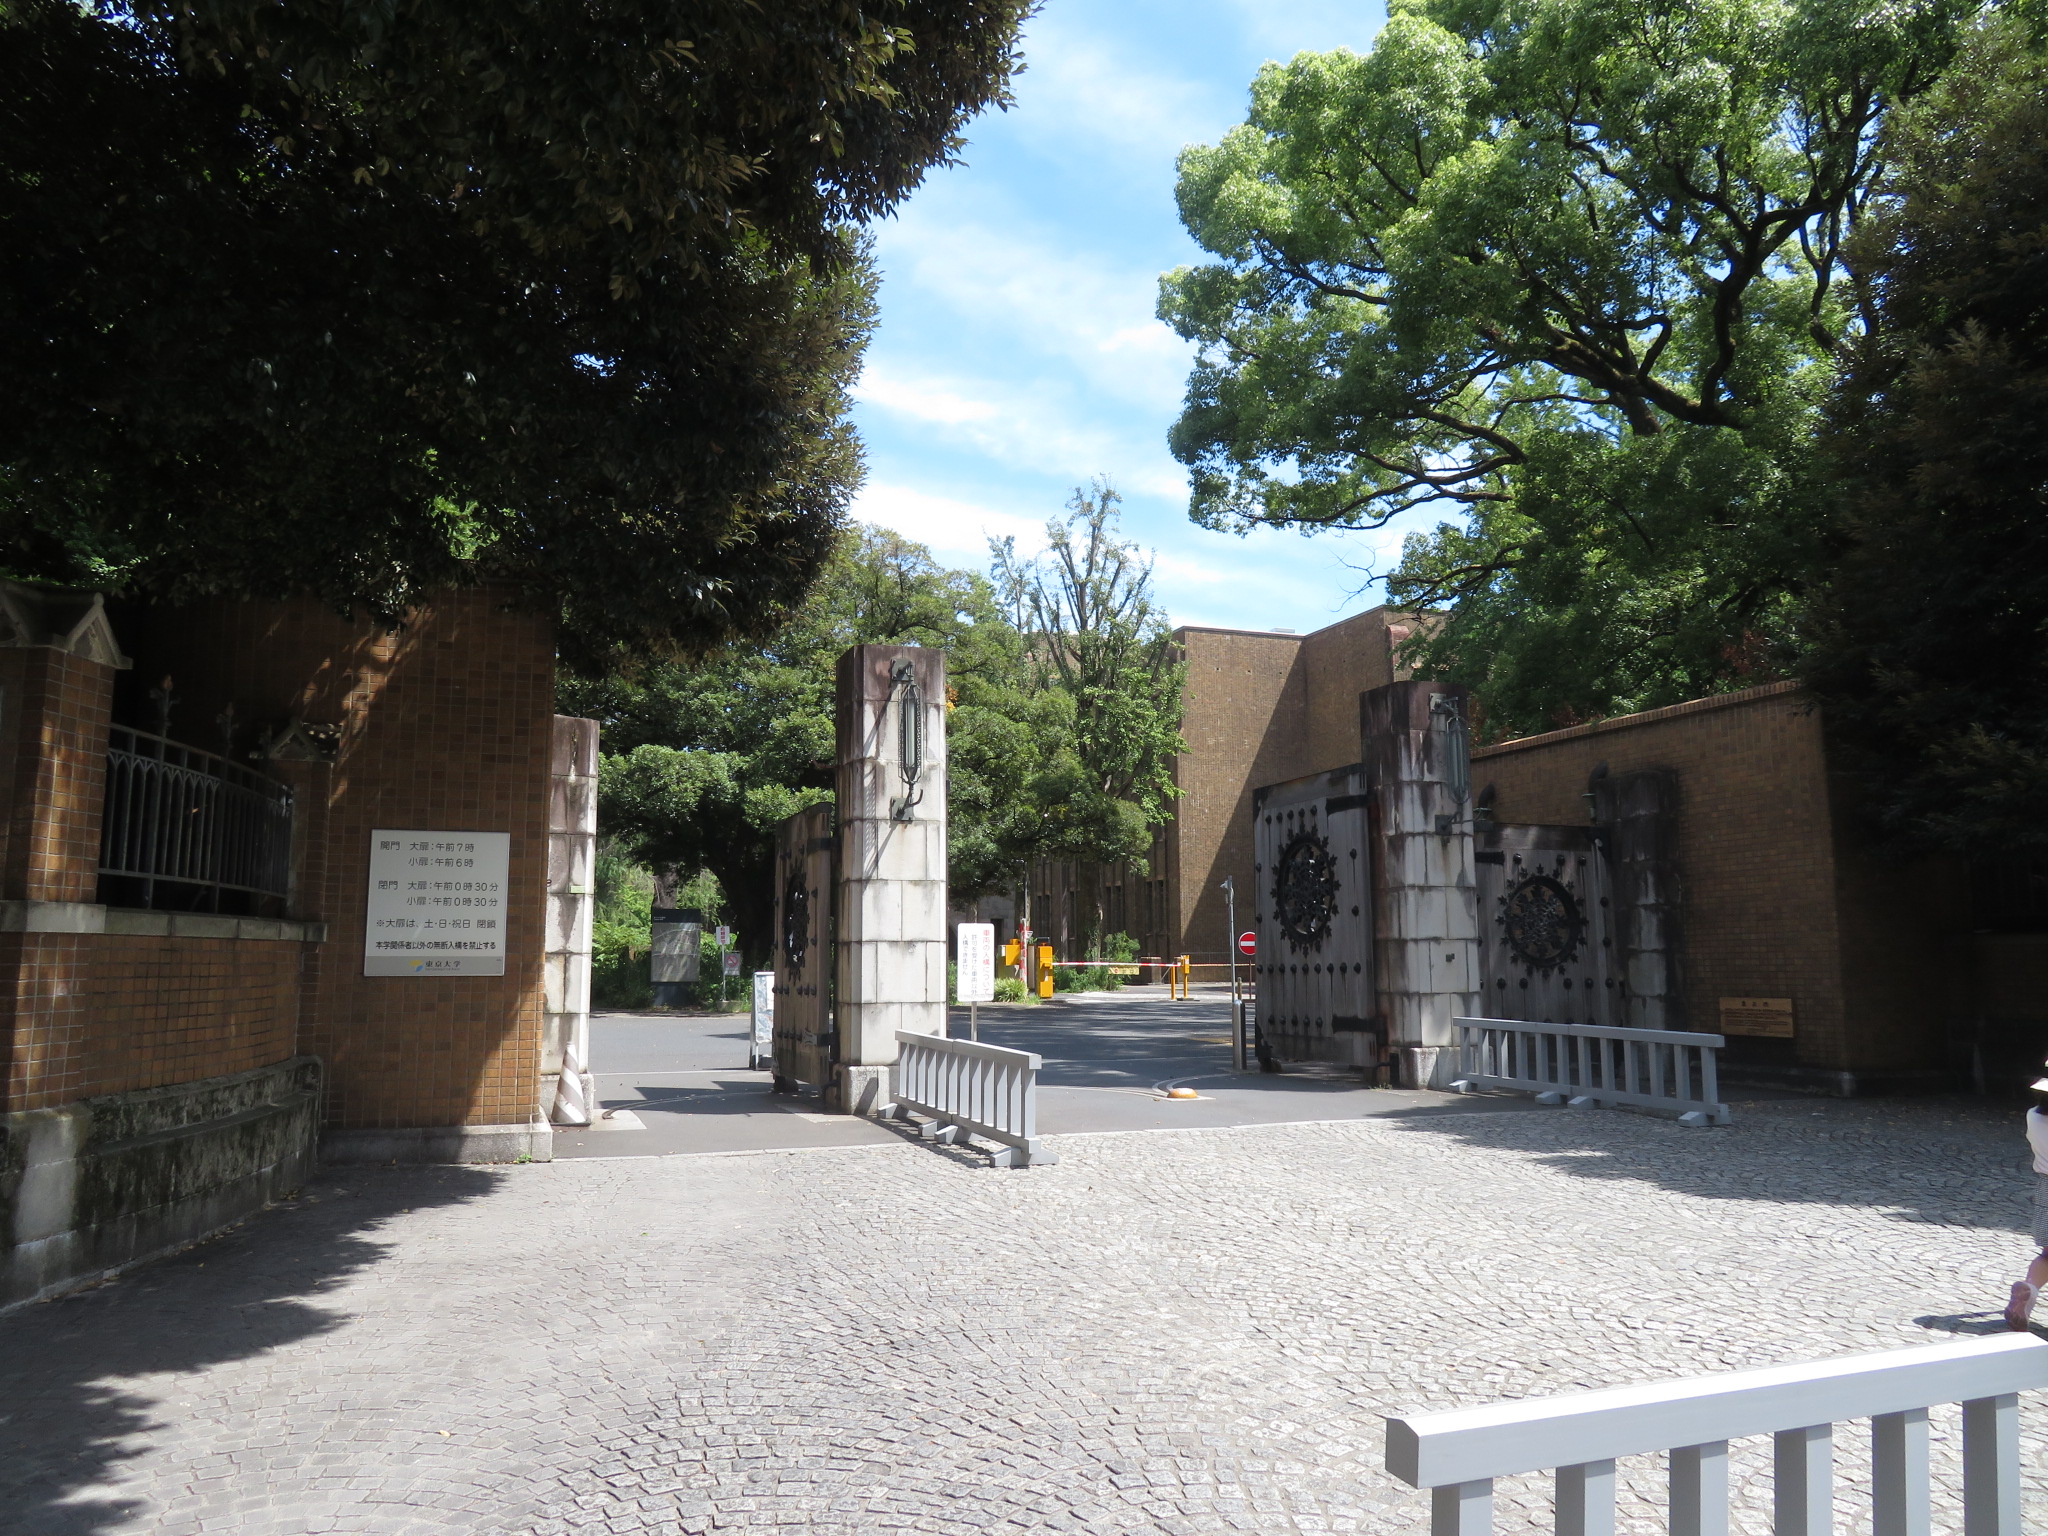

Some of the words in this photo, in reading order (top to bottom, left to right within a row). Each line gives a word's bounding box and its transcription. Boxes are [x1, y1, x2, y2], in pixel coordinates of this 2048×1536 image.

[380, 840, 400, 851] 開門
[378, 880, 399, 891] 閉門
[476, 919, 496, 929] 閉鎖
[425, 960, 461, 968] 東京大学
